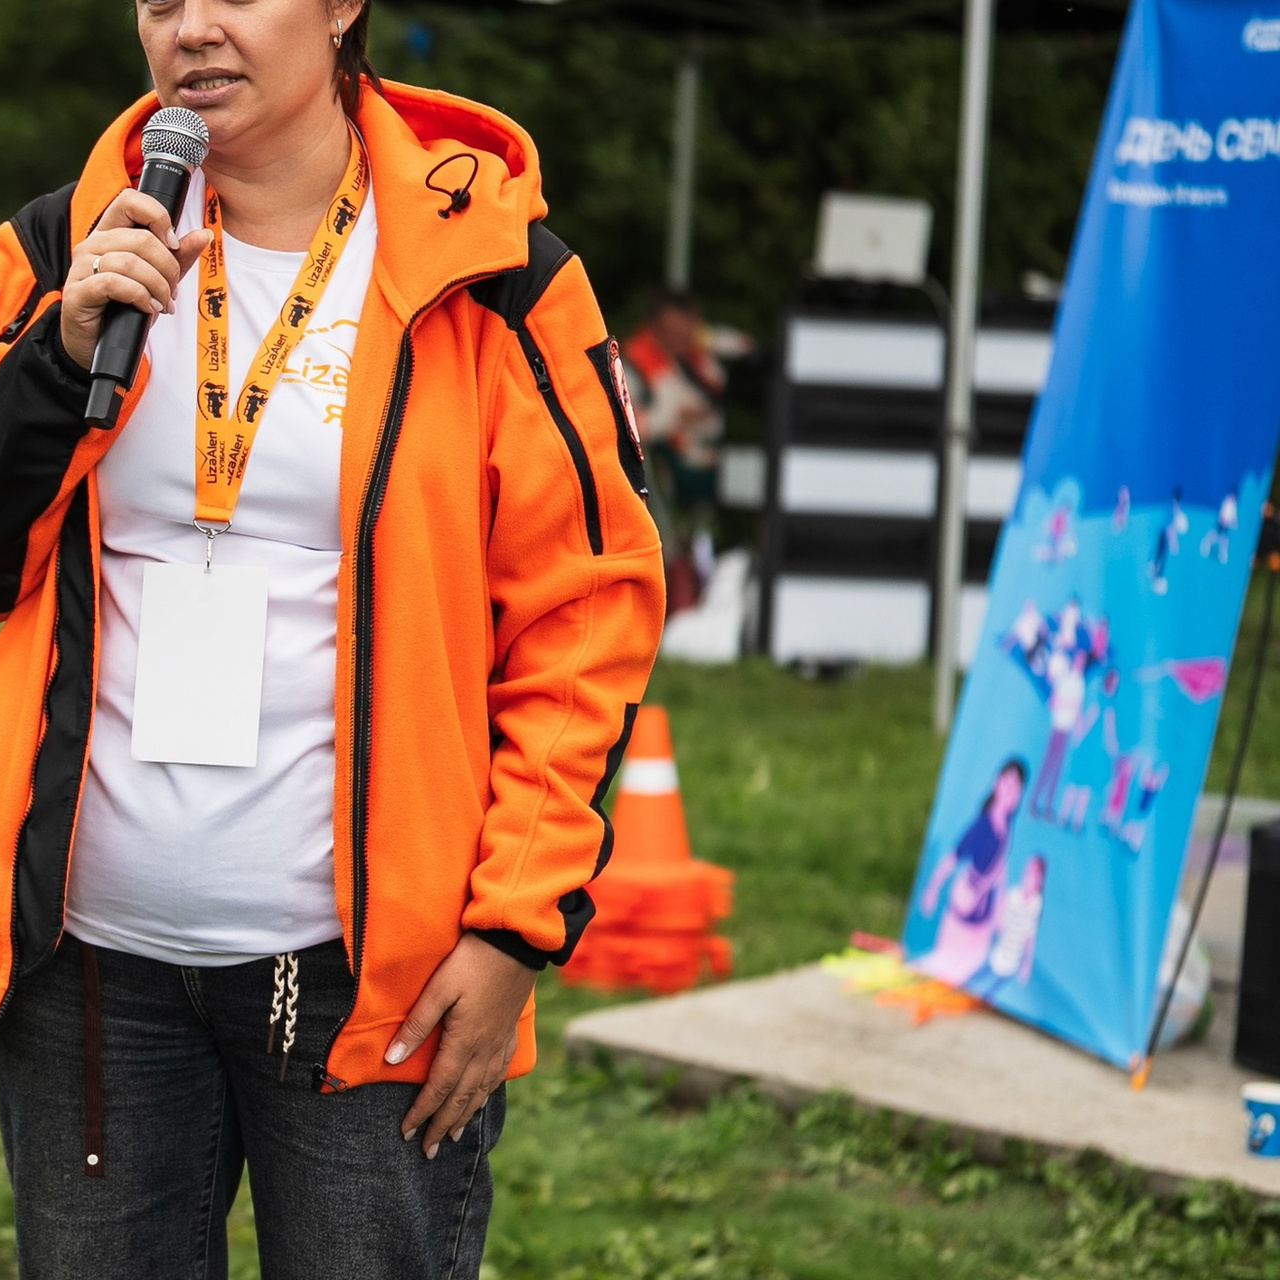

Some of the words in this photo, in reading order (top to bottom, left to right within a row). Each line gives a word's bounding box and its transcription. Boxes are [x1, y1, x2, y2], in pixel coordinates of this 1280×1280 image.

[208, 239, 217, 278] LizaAle
[305, 241, 333, 288] LizaAlert
[209, 329, 219, 371] LizaAlert
[260, 333, 288, 375] LizaAlert
[206, 431, 218, 484] LizaAlert
